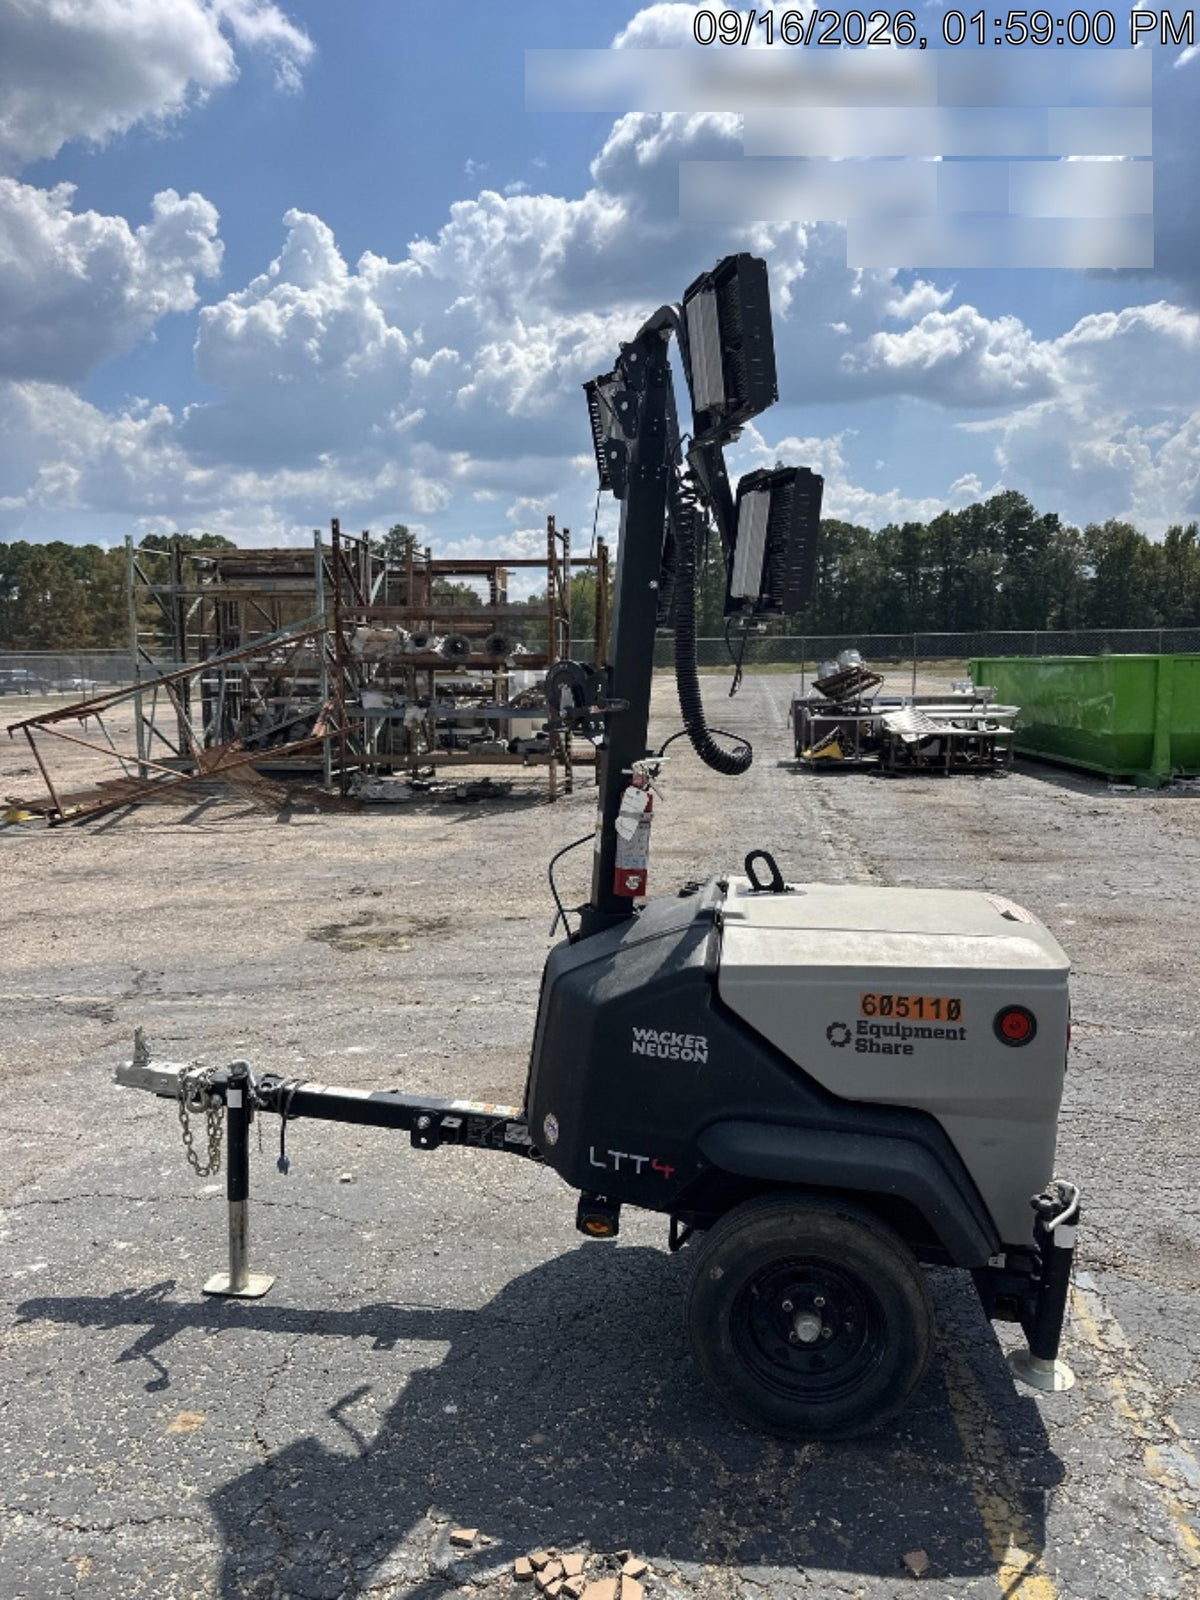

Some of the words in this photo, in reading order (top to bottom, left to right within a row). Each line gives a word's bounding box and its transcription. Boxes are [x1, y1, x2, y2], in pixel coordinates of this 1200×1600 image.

[861, 994, 962, 1021] 605110
[632, 1026, 709, 1050] WACKER
[856, 1020, 967, 1041] Equipment
[632, 1041, 709, 1064] NEUSON
[854, 1038, 914, 1055] Share
[589, 1146, 675, 1179] LTT4
